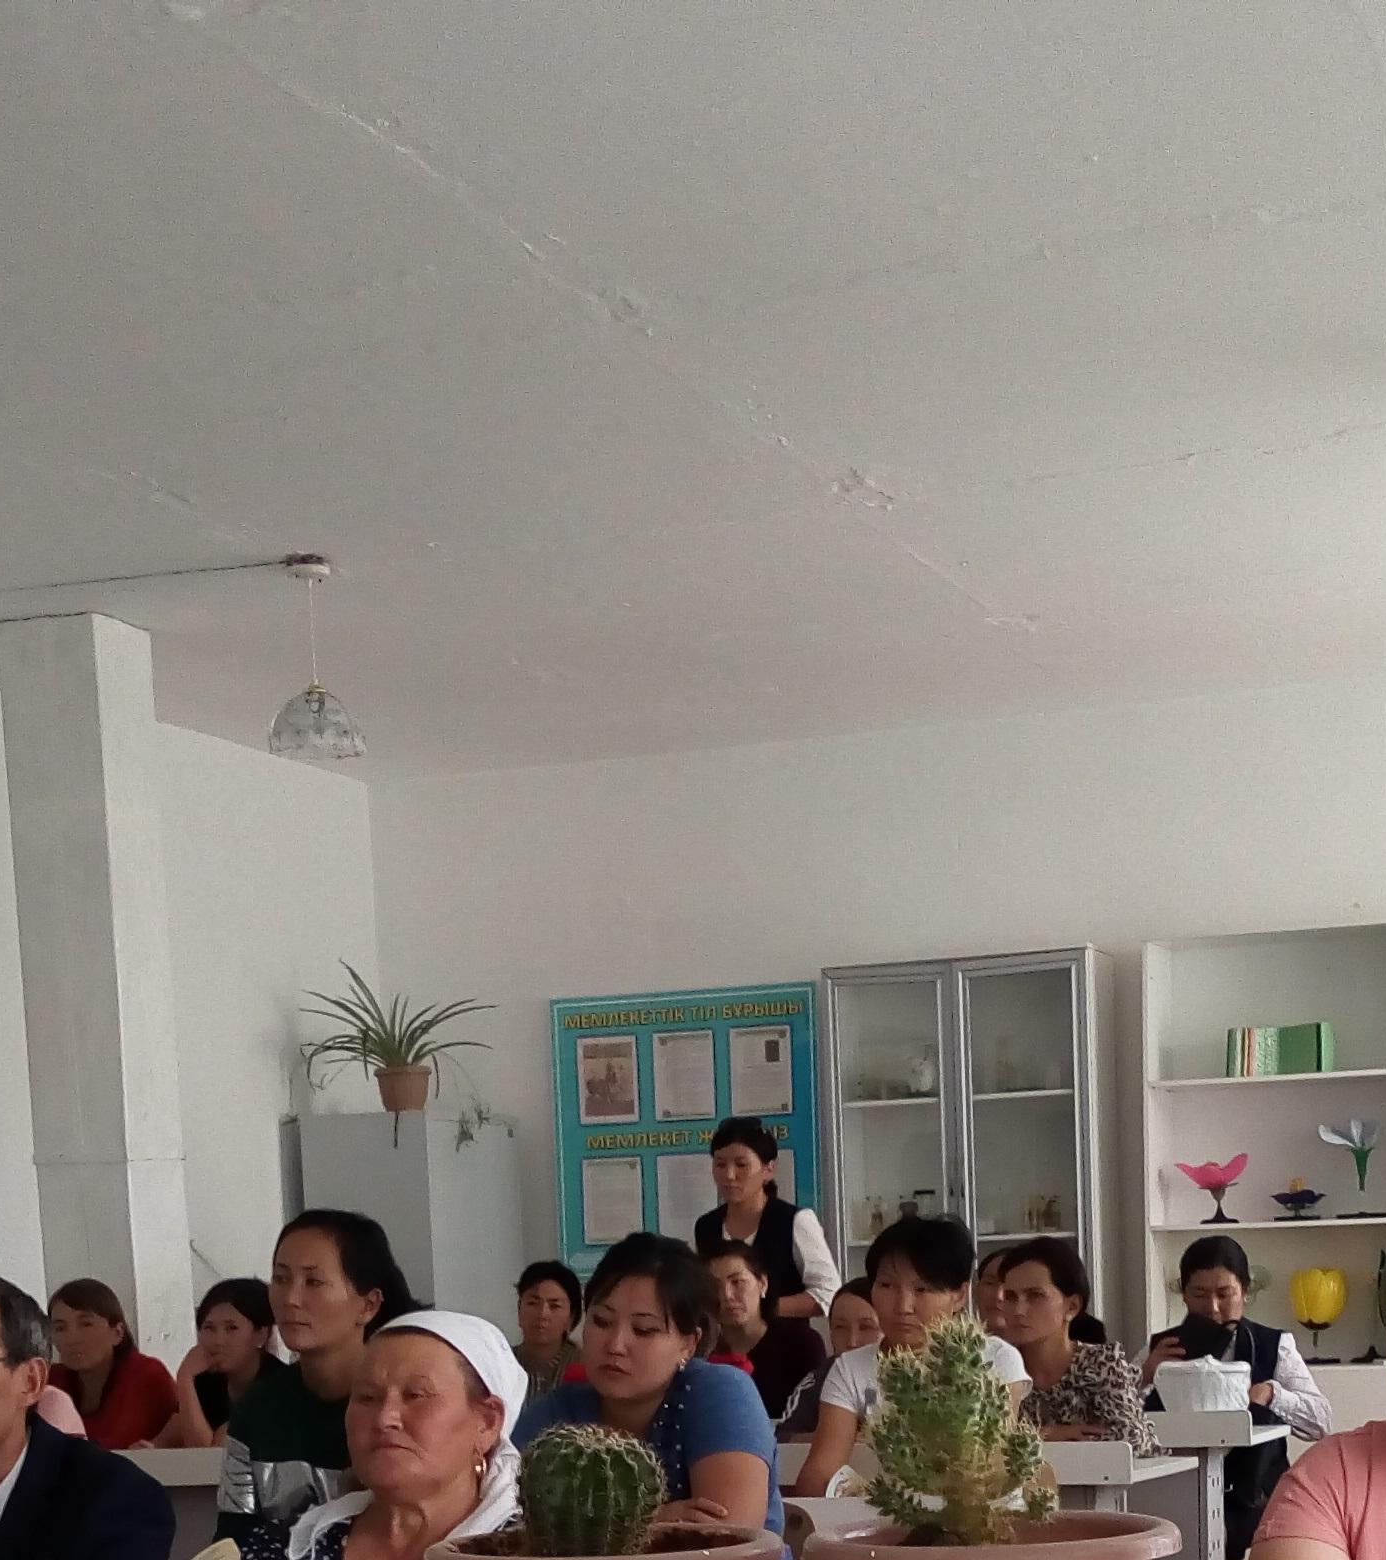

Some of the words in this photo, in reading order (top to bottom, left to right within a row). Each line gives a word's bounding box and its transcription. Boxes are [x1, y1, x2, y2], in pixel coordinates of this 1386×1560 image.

[564, 1008, 685, 1029] МЕМЛЕКЕТТІК
[691, 1006, 717, 1023] ТІЛ
[586, 1130, 693, 1150] МЕМЛЕКЕТ
